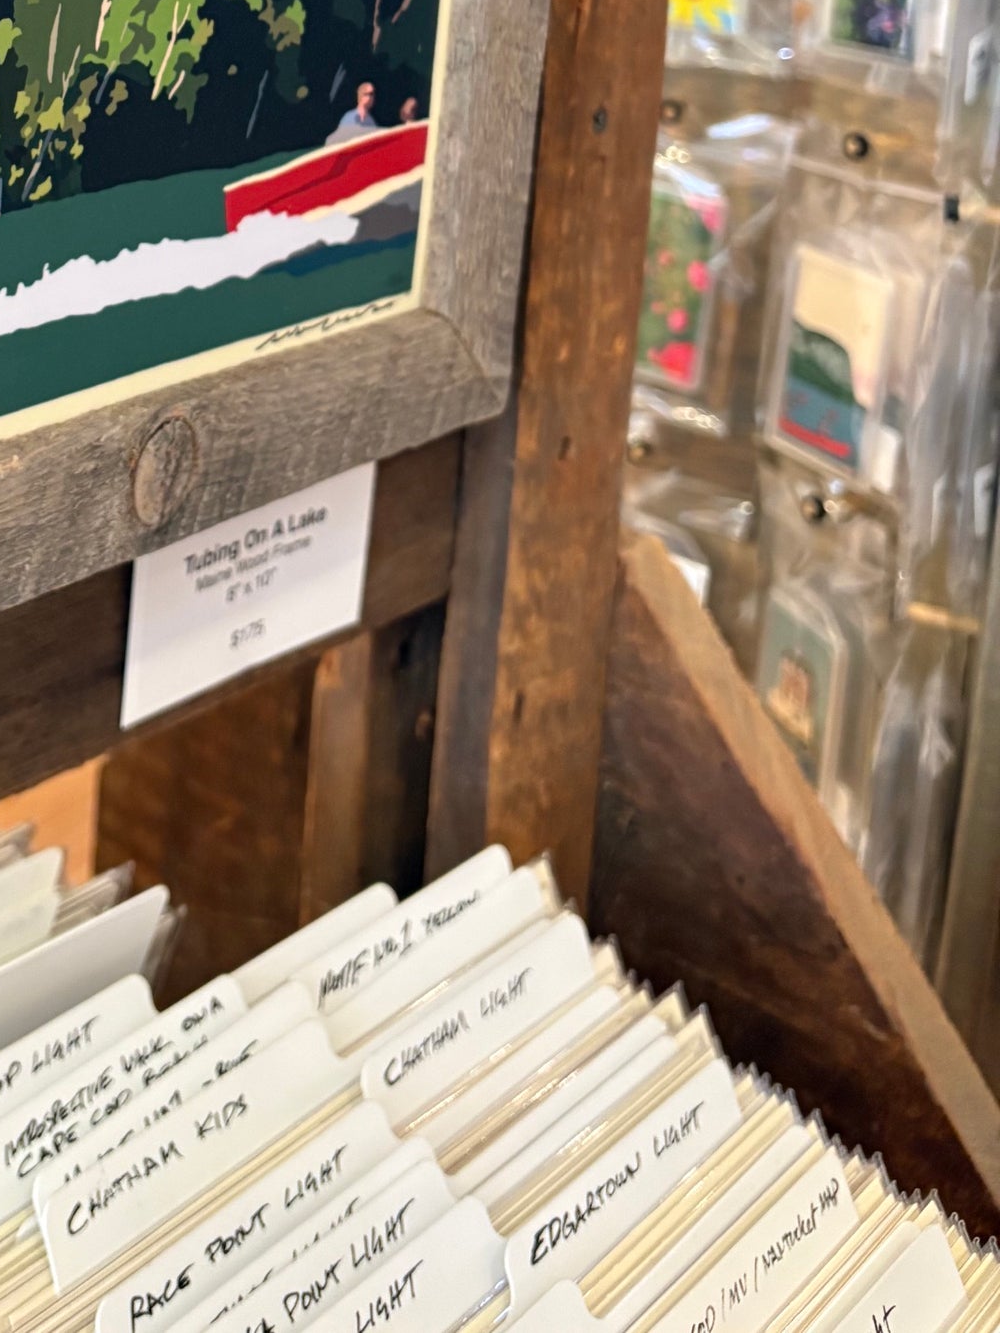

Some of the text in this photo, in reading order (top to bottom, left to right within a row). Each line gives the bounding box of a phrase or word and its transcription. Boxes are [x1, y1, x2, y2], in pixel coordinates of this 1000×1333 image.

[184, 507, 328, 574] Tubing On A Lake
[272, 536, 312, 558] Frame
[31, 1014, 101, 1073] LIGHT
[383, 966, 534, 1086] CHATHAM LIGHT
[17, 1121, 80, 1179] CAPE
[89, 1088, 133, 1126] COD
[67, 1140, 185, 1236] CHATHAM
[194, 1093, 249, 1141] KIDS
[530, 1101, 705, 1265] EDGARTOWN LIGHT
[130, 1262, 195, 1333] RACE
[204, 1202, 270, 1263] POINT
[284, 1144, 348, 1209] LIGHT
[282, 1257, 343, 1324] POINT
[351, 1197, 416, 1268] LIGHT
[356, 1259, 424, 1333] LIGHT
